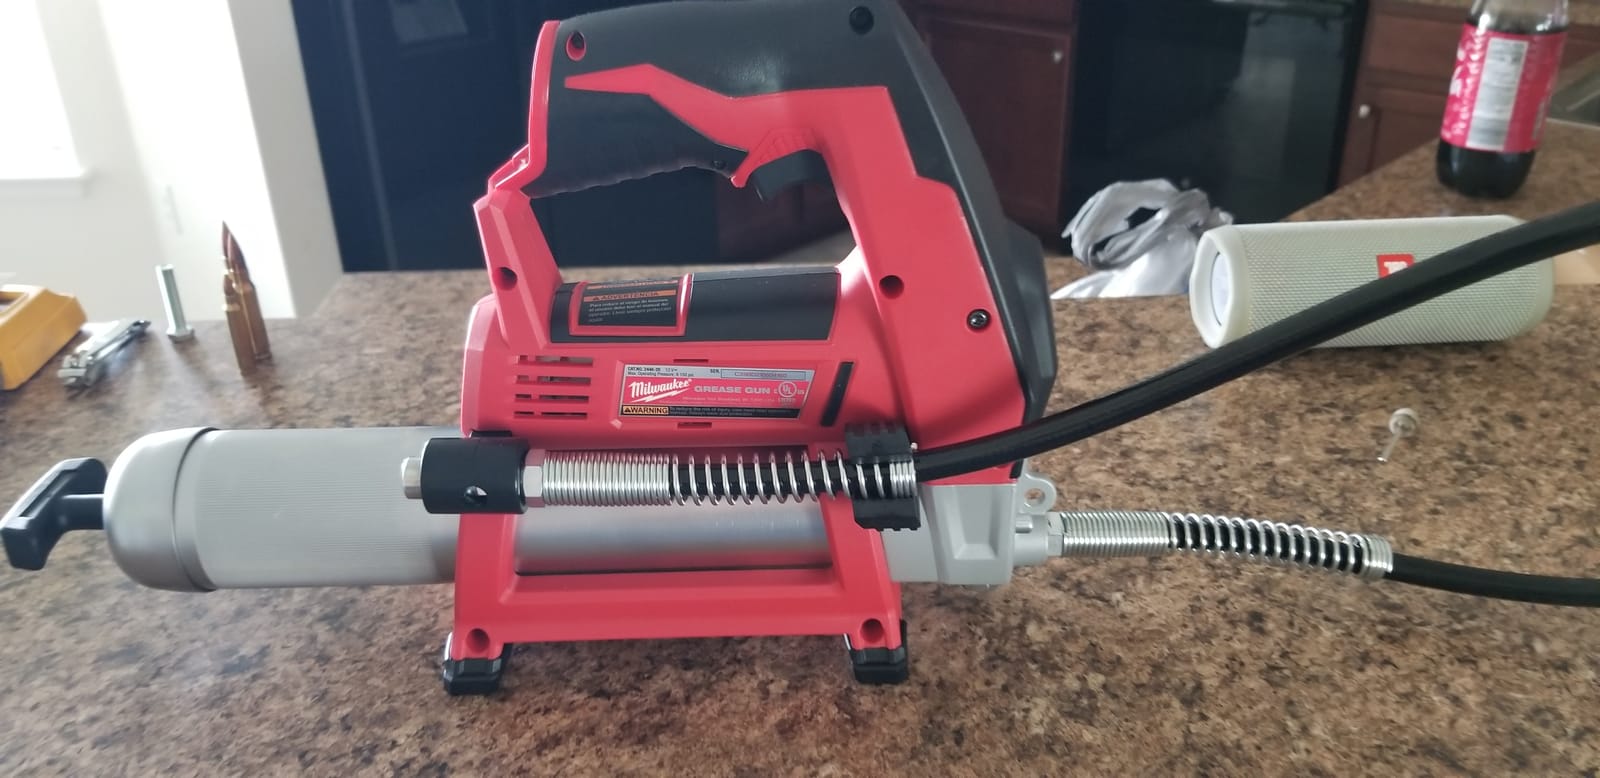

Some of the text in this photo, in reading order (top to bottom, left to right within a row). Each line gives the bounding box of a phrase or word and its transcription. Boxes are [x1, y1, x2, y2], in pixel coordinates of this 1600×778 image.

[601, 291, 659, 301] ADVERTENCIA
[628, 378, 691, 399] Milwaukee
[693, 385, 771, 395] GREASE GUN
[630, 406, 668, 414] WARNING
